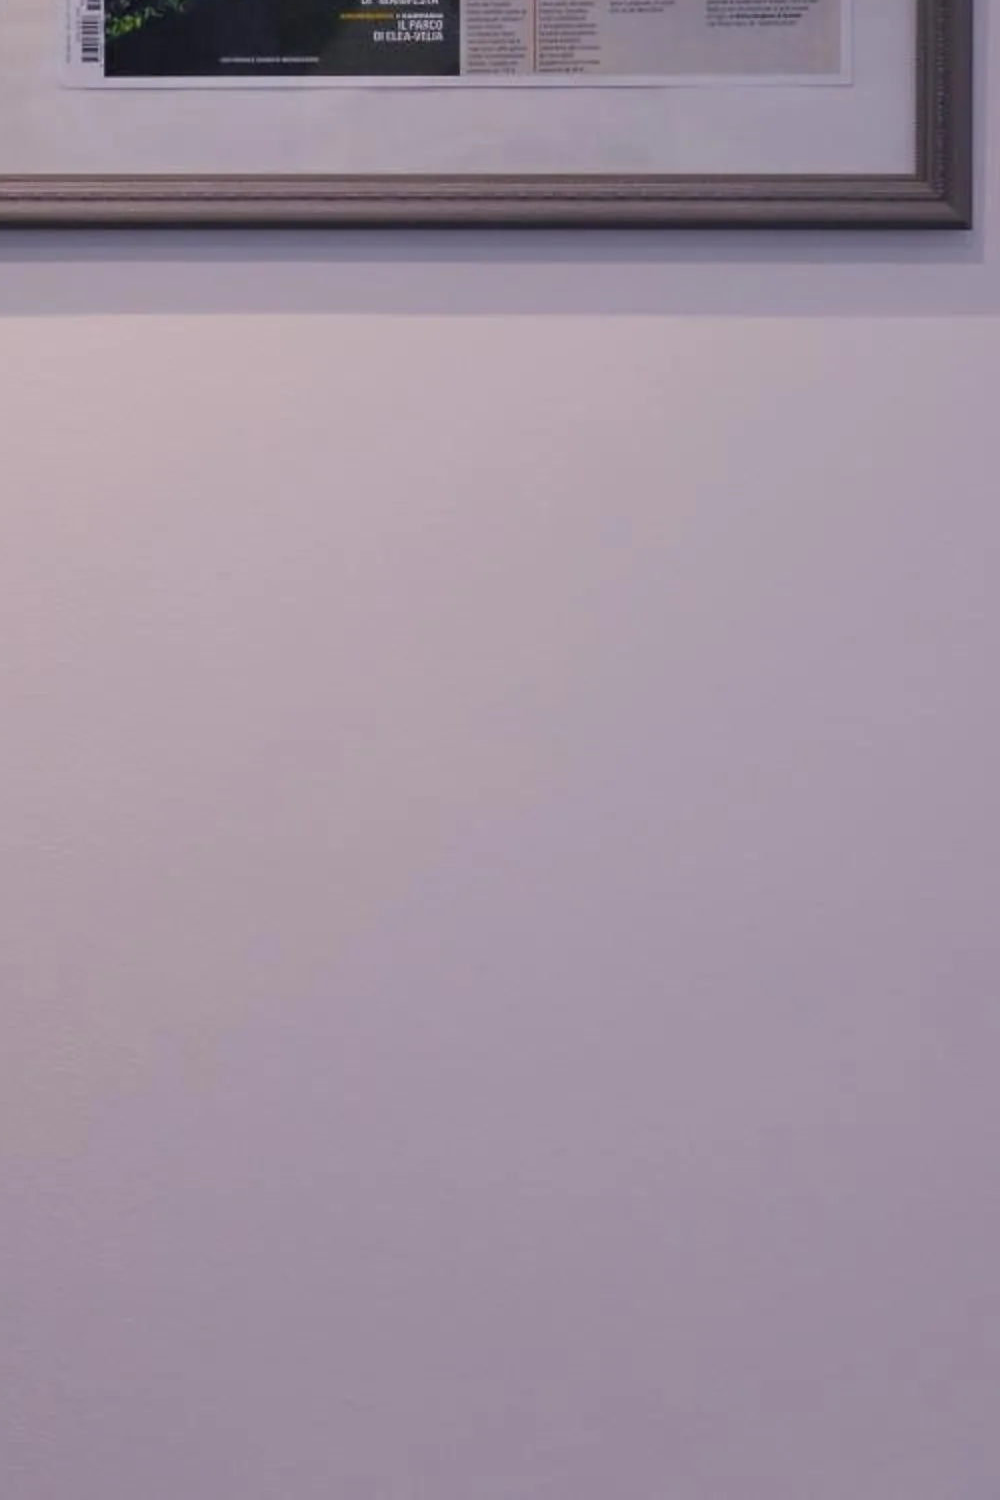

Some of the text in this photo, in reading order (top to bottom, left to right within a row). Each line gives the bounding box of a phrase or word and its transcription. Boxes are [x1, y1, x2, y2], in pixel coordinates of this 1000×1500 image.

[397, 20, 443, 30] IL PARCO
[373, 32, 385, 42] DI
